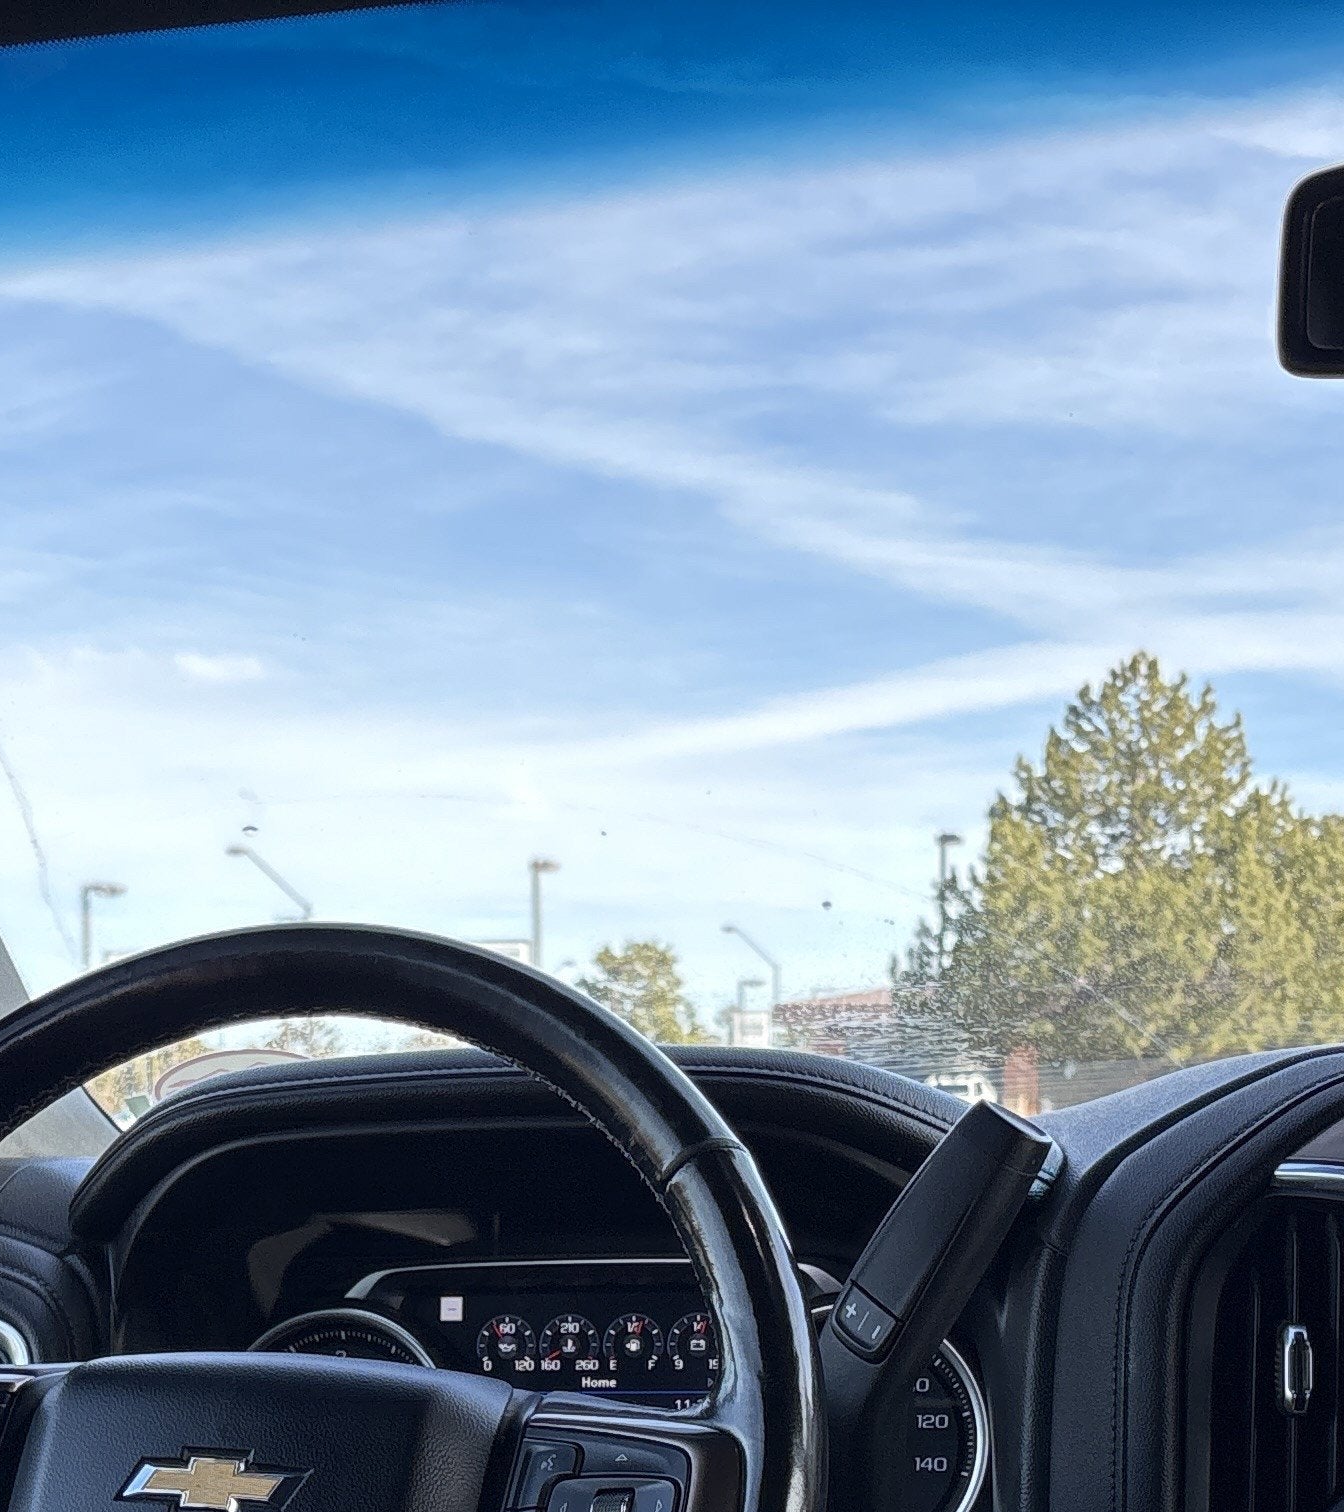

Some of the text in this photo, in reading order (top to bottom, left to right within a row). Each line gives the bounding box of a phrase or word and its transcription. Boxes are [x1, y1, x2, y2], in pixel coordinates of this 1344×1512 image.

[560, 1322, 580, 1333] 210
[483, 1360, 492, 1372] 0
[515, 1360, 535, 1371] 120
[540, 1360, 561, 1371] 160
[575, 1360, 599, 1371] 260
[609, 1360, 617, 1371] E
[647, 1359, 656, 1370] F
[674, 1359, 684, 1370] 9
[581, 1376, 617, 1389] Home
[916, 1413, 949, 1429] 120
[914, 1456, 947, 1472] 140
